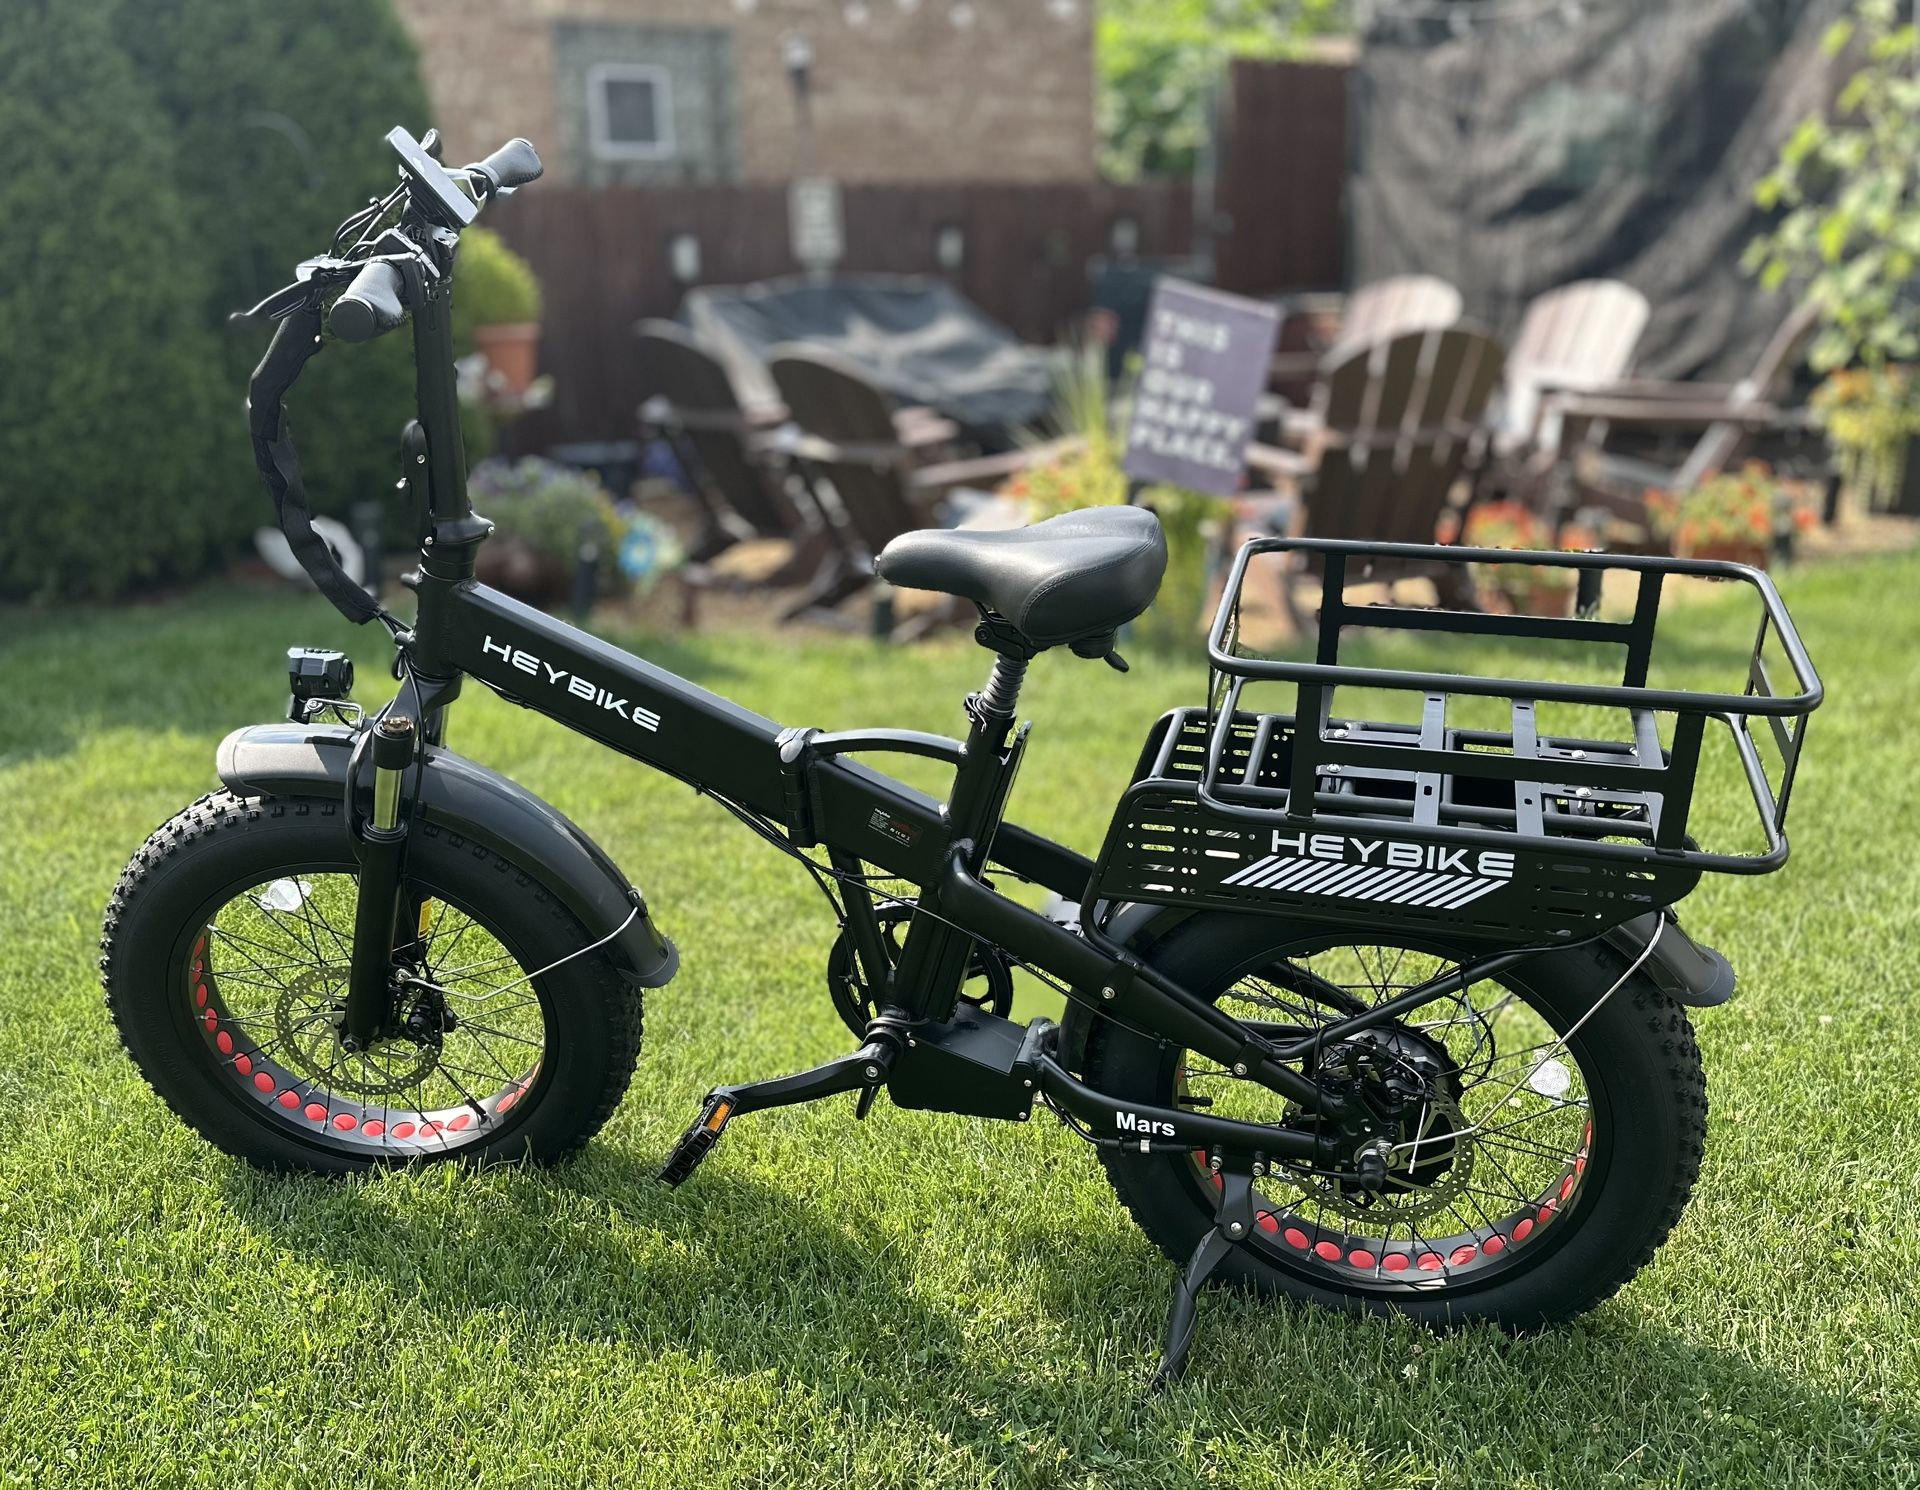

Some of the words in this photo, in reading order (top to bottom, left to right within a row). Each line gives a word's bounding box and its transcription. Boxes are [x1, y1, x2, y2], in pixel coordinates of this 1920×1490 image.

[482, 635, 661, 732] HEYBIKE
[1271, 829, 1515, 878] HEYBIKE
[1116, 1111, 1176, 1137] Mars
